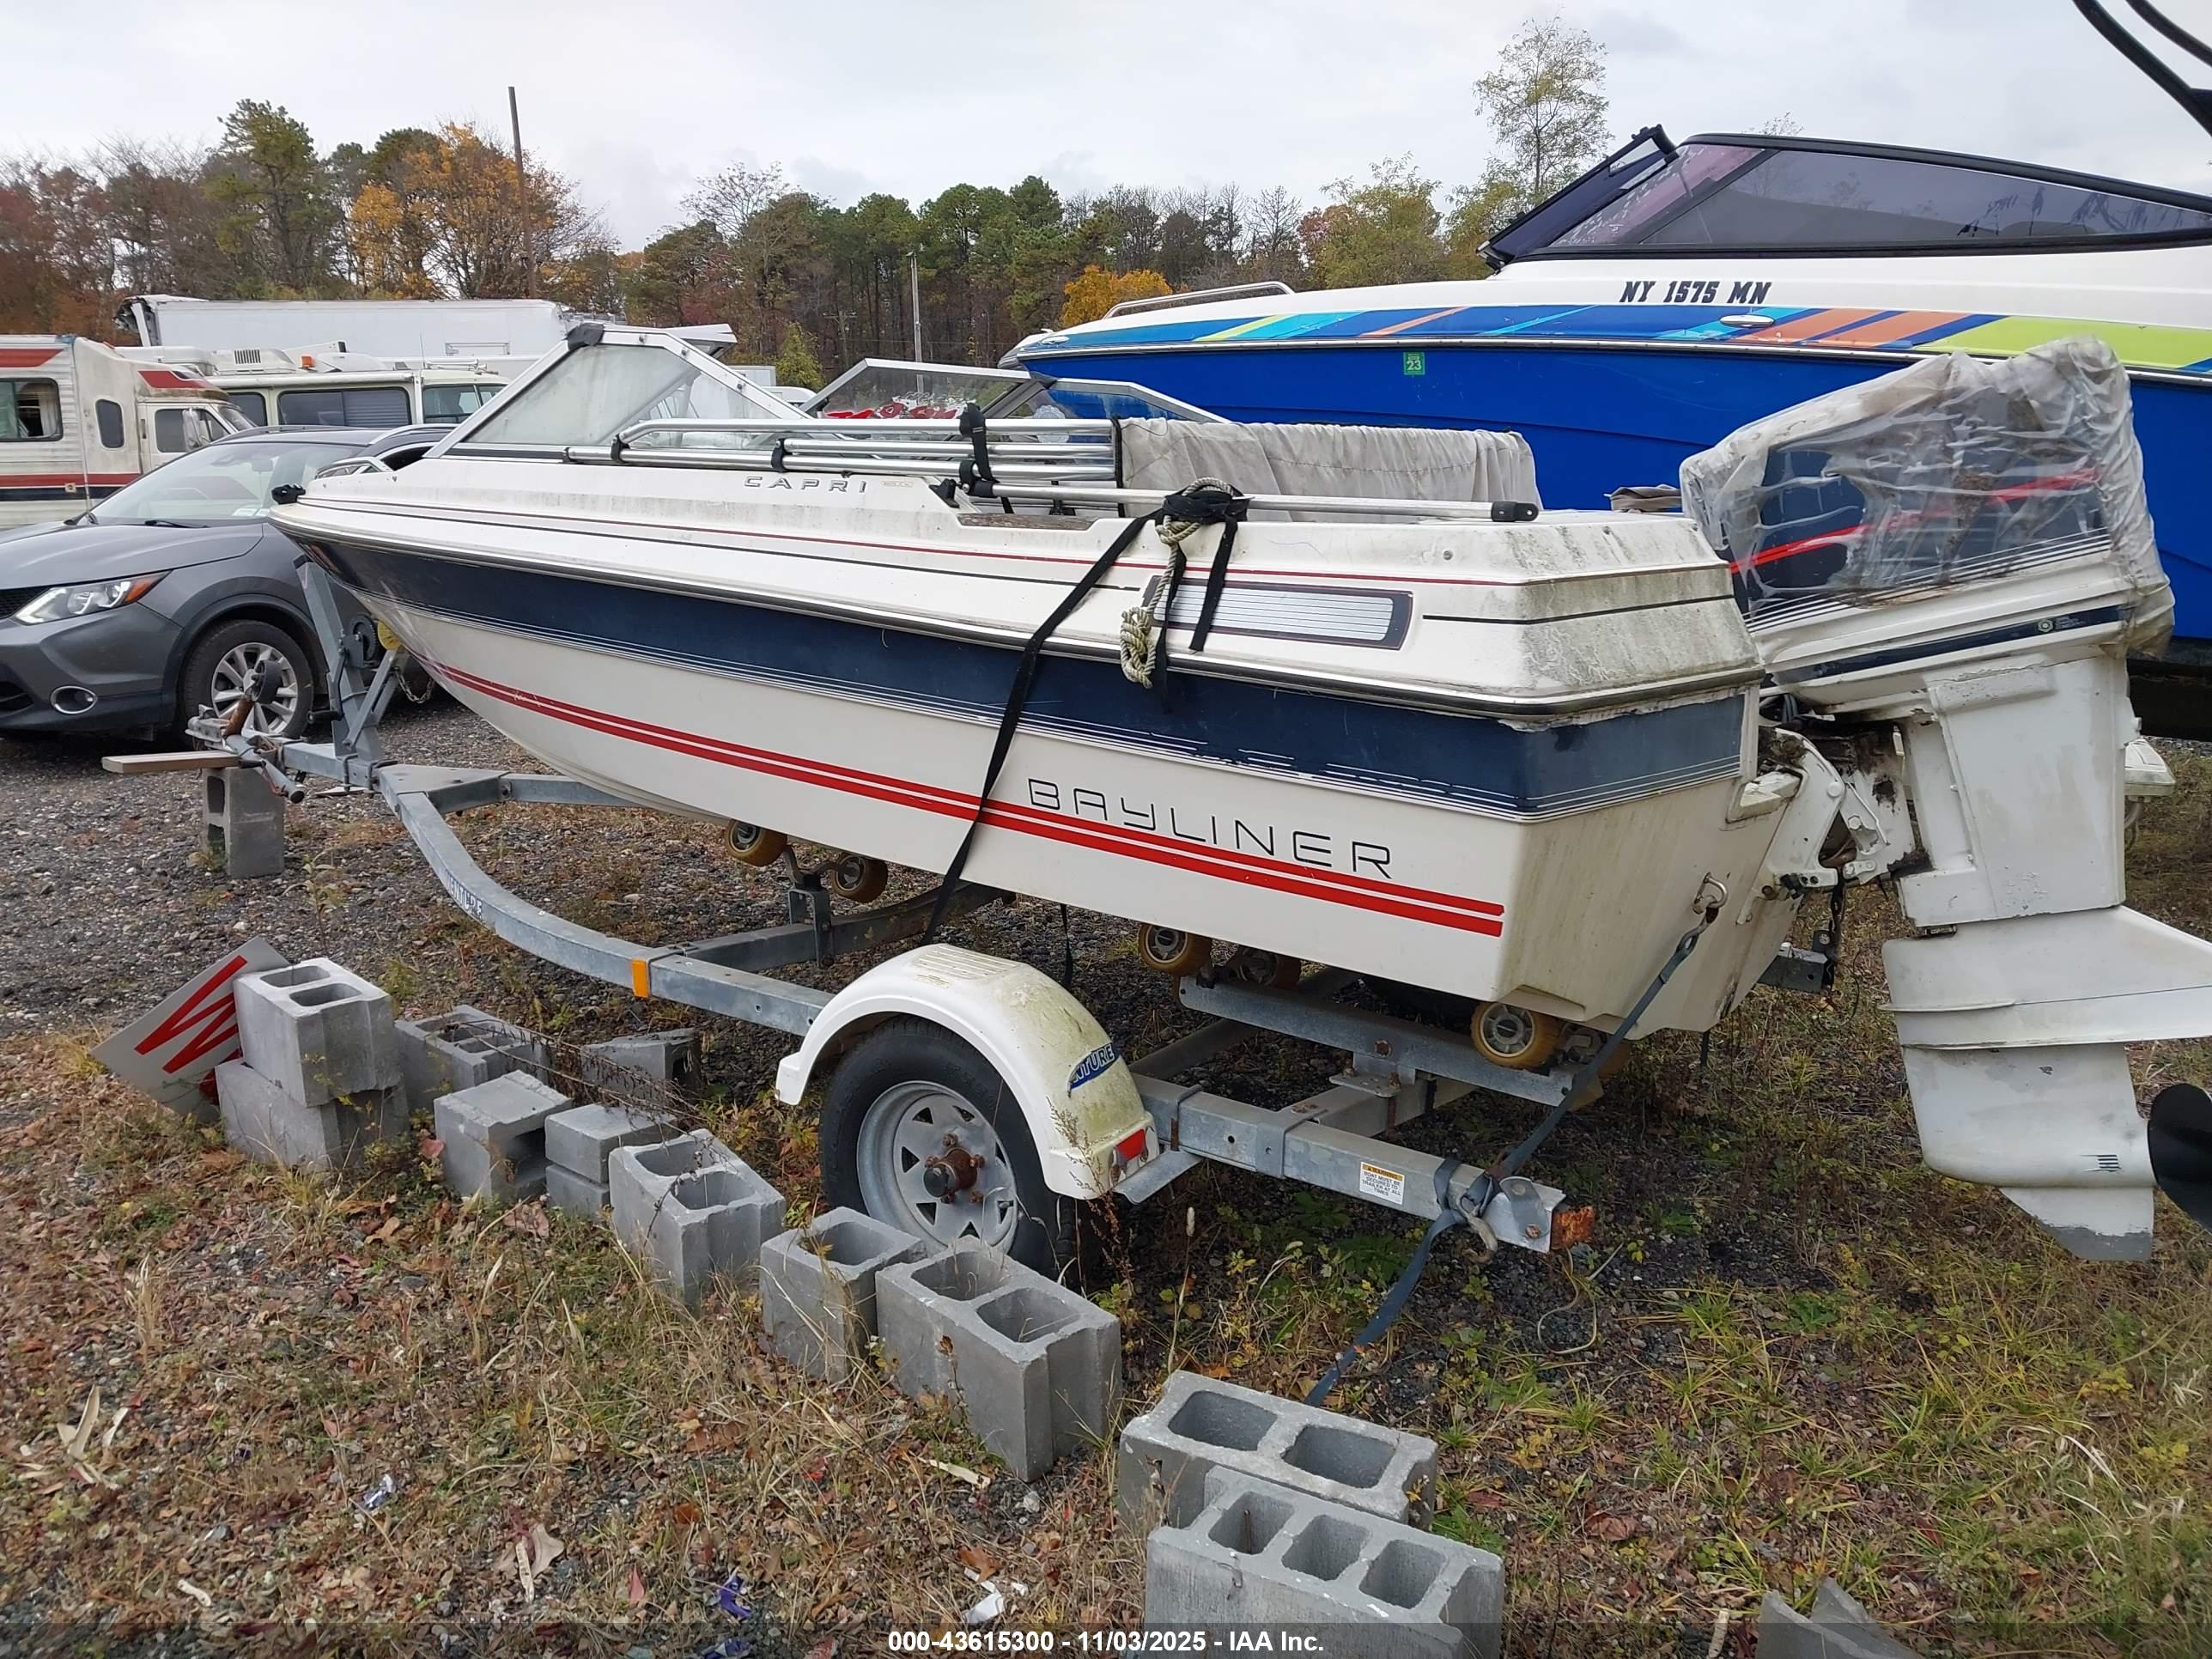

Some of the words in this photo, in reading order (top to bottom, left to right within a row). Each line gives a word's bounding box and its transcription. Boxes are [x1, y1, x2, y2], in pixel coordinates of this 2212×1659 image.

[1619, 281, 1656, 302] NY
[1663, 281, 1720, 303] 1575
[1726, 282, 1773, 304] MN
[1407, 360, 1422, 371] 23
[744, 476, 867, 493] CAPRI
[1028, 778, 1392, 879] BAYLINER
